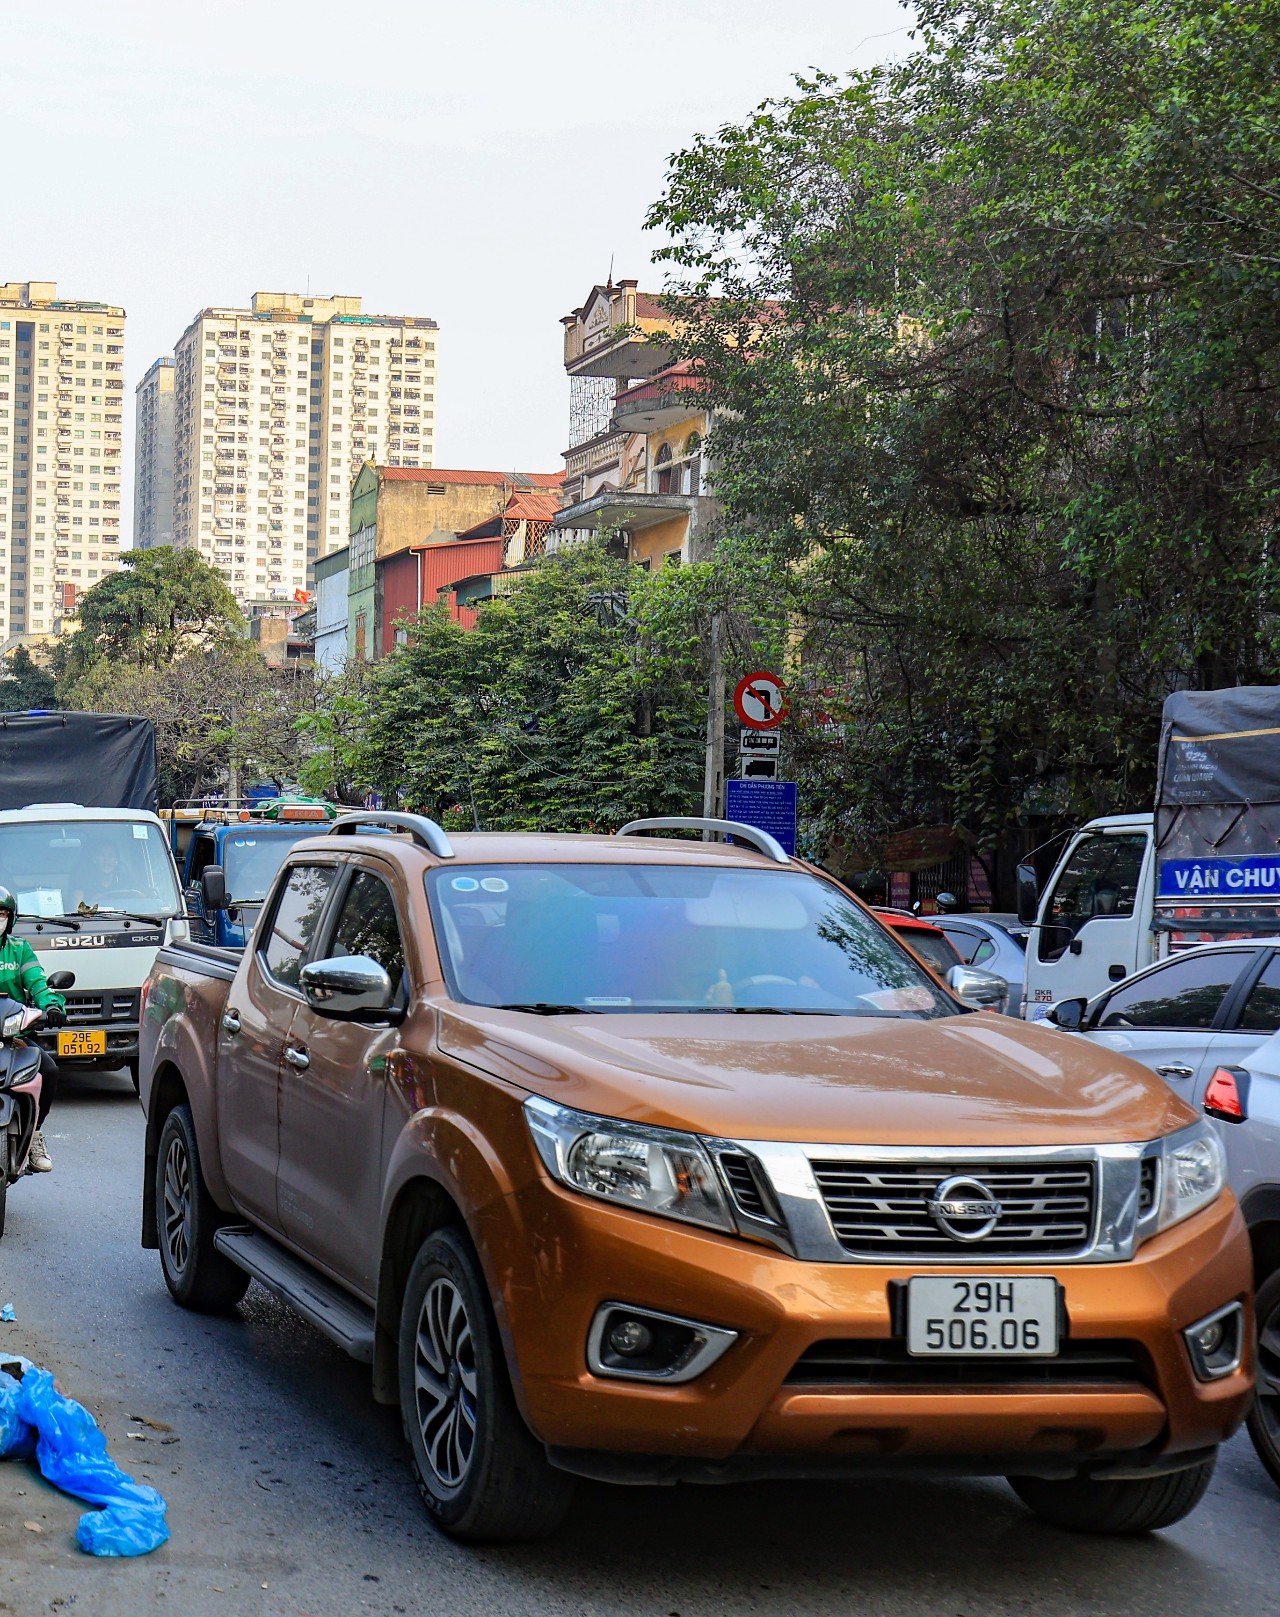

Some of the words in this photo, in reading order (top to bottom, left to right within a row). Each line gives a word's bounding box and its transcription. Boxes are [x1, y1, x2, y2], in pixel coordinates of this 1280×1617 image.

[1175, 865, 1219, 894] VẬN
[1226, 867, 1280, 888] CHU
[51, 936, 105, 947] ISUZU
[72, 1032, 92, 1042] 29E
[63, 1043, 100, 1054] 051.92
[940, 1204, 999, 1215] NISSAN
[953, 1282, 1013, 1313] 29H
[926, 1318, 1040, 1349] 506.06
